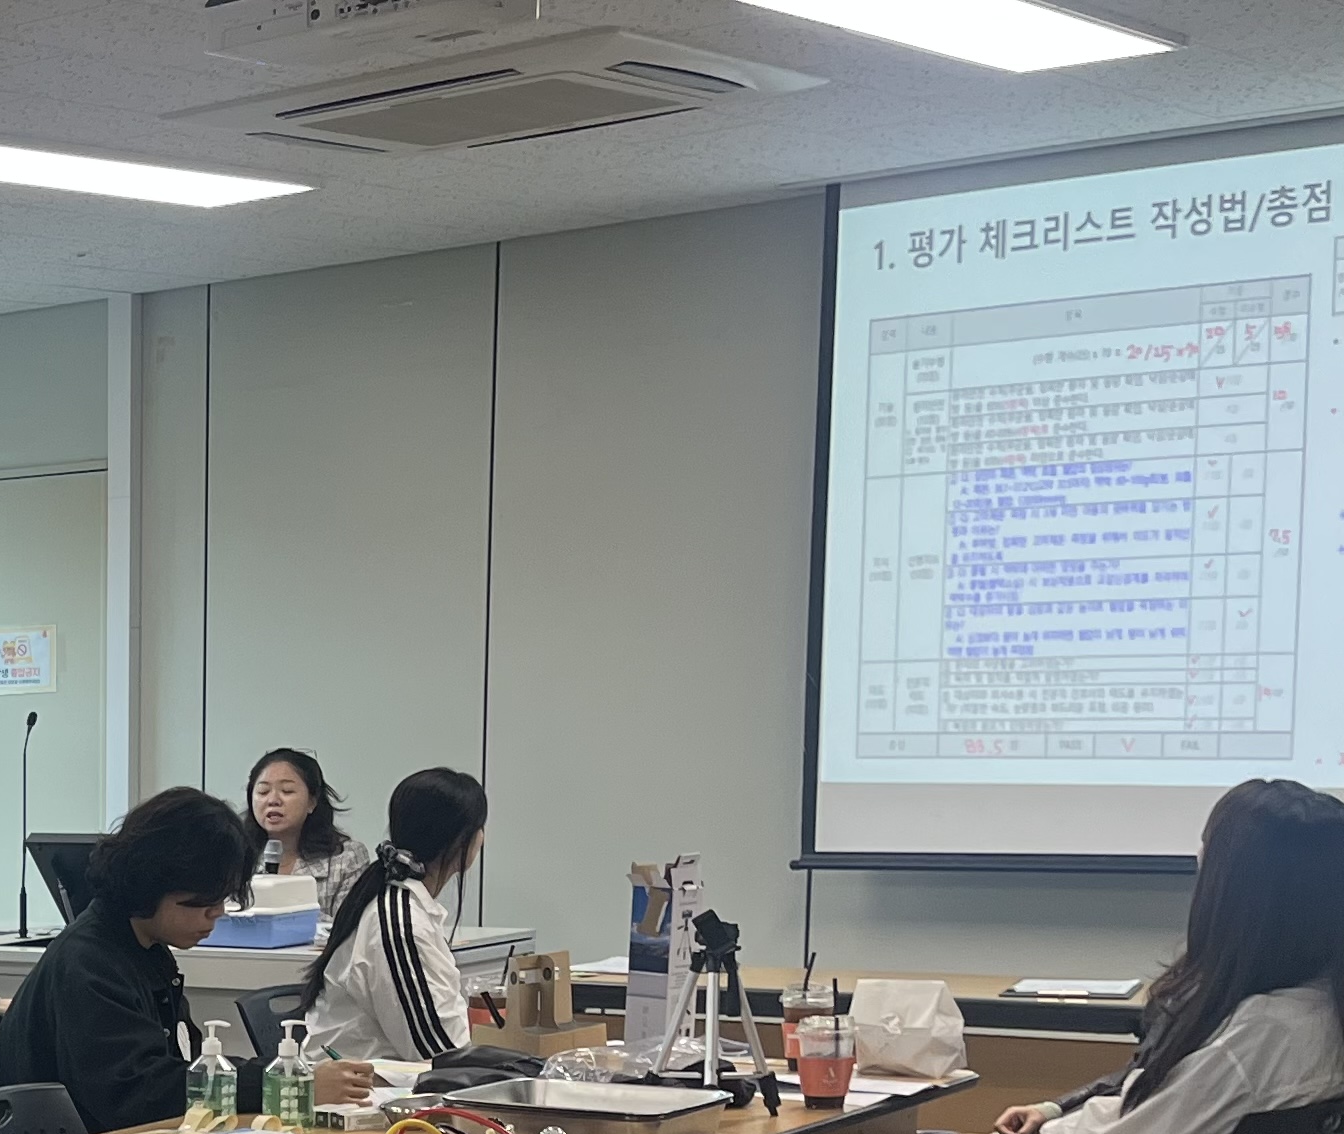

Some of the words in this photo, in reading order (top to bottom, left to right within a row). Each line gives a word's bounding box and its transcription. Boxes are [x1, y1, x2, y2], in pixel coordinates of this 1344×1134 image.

[873, 238, 895, 271] 1.
[907, 223, 968, 269] 평가
[978, 205, 1136, 261] 체크리스트
[1150, 179, 1333, 239] 작성법/총점
